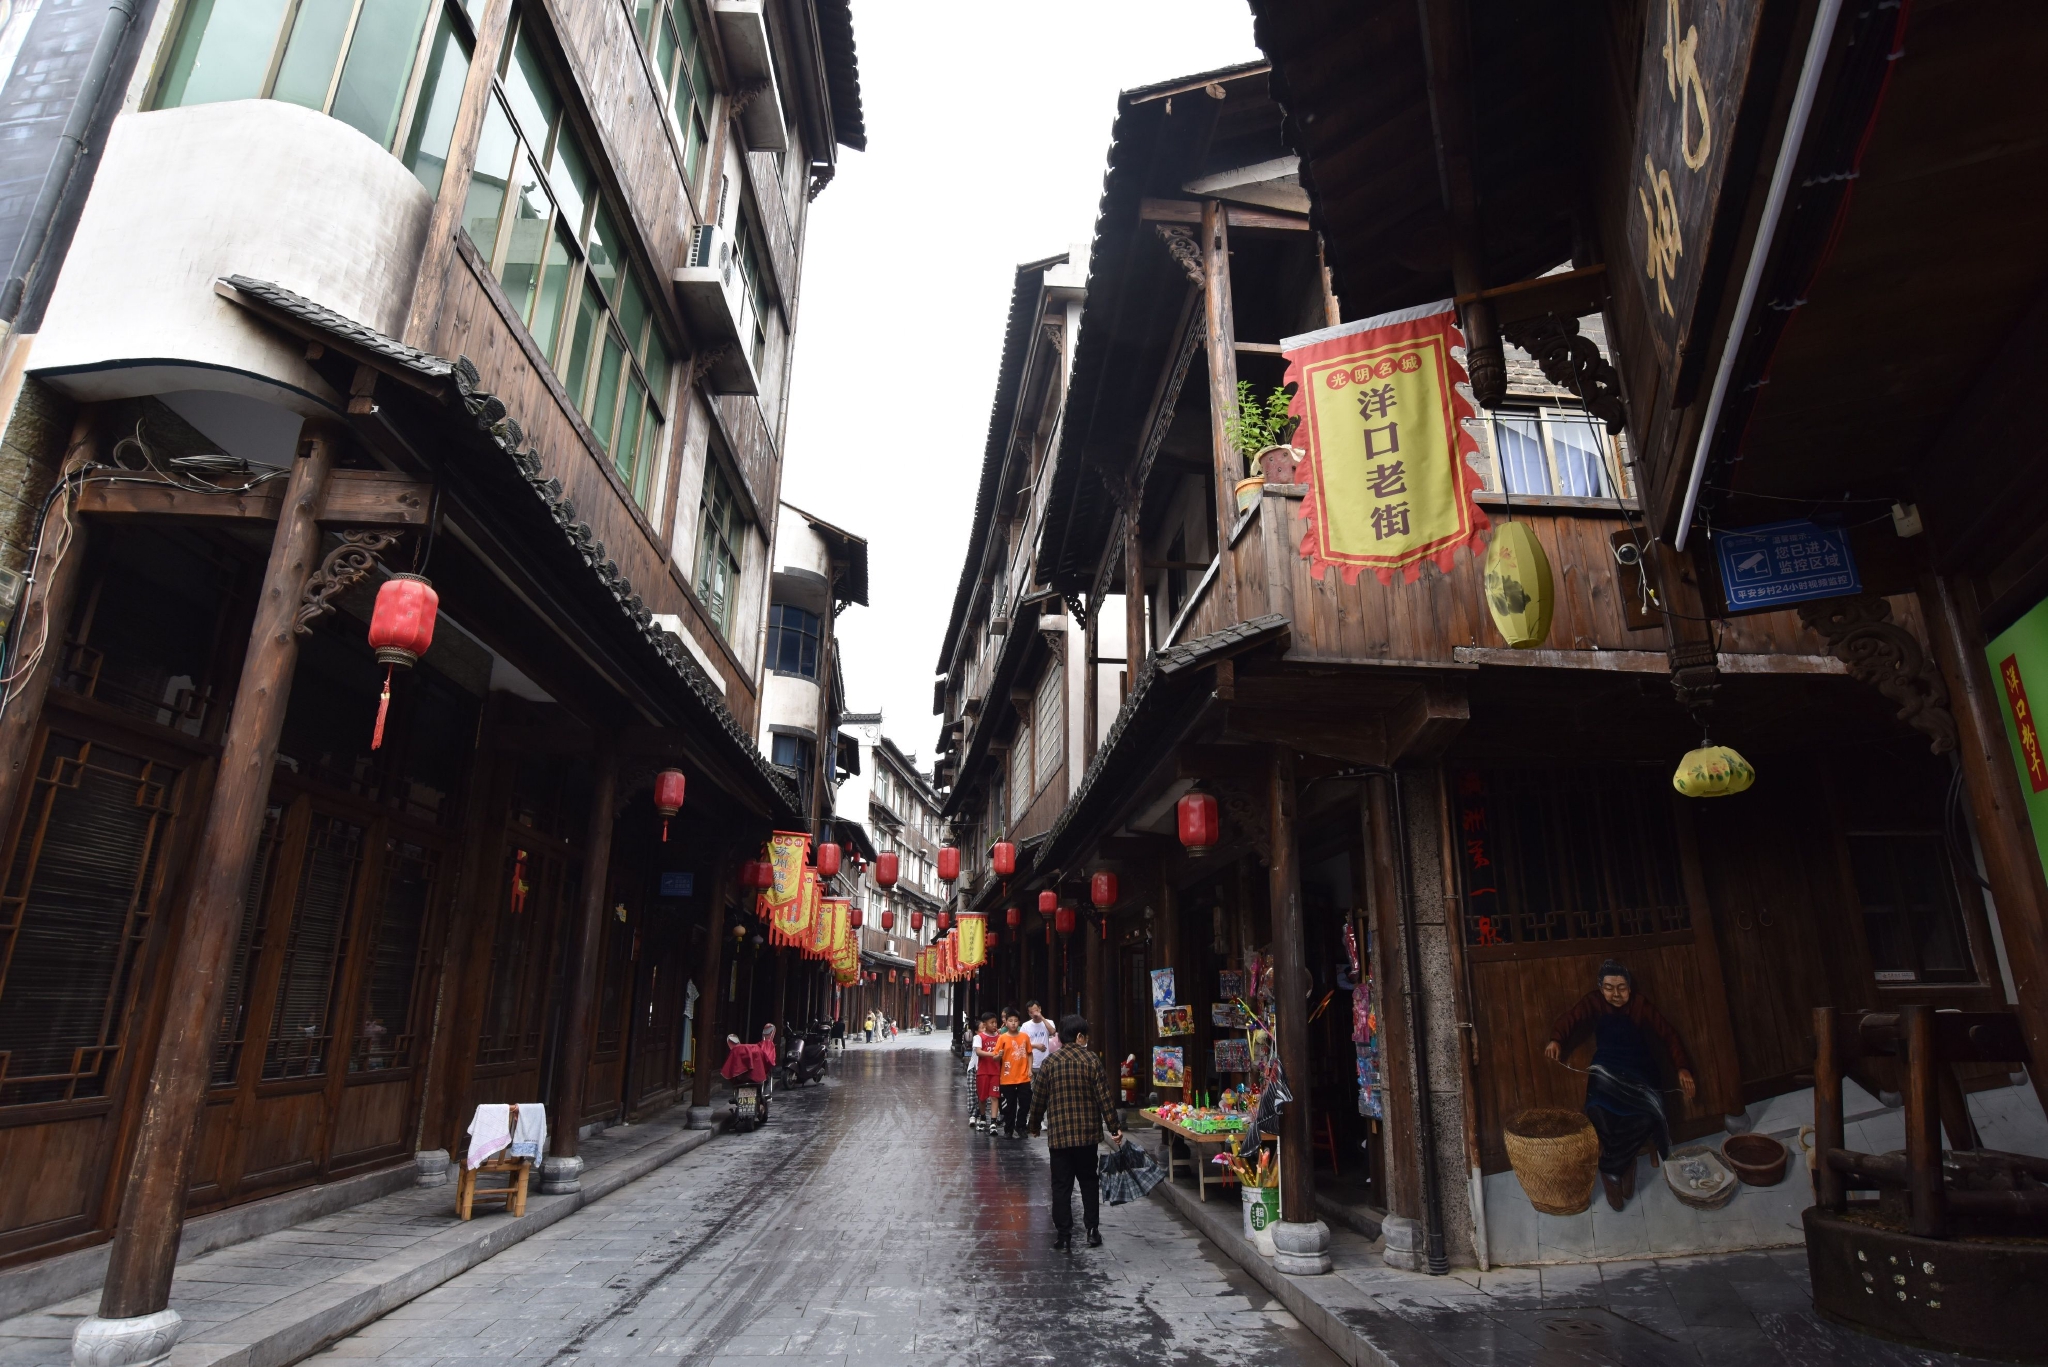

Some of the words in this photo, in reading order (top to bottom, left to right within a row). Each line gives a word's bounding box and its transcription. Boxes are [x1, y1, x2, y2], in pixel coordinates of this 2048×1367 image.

[1330, 355, 1419, 387] 光阴名城
[1357, 383, 1411, 541] 洋口老街
[1775, 539, 1837, 560] 您已进入
[1779, 553, 1841, 575] 监控区域
[1737, 575, 1848, 599] 平安乡村24小时视频监控
